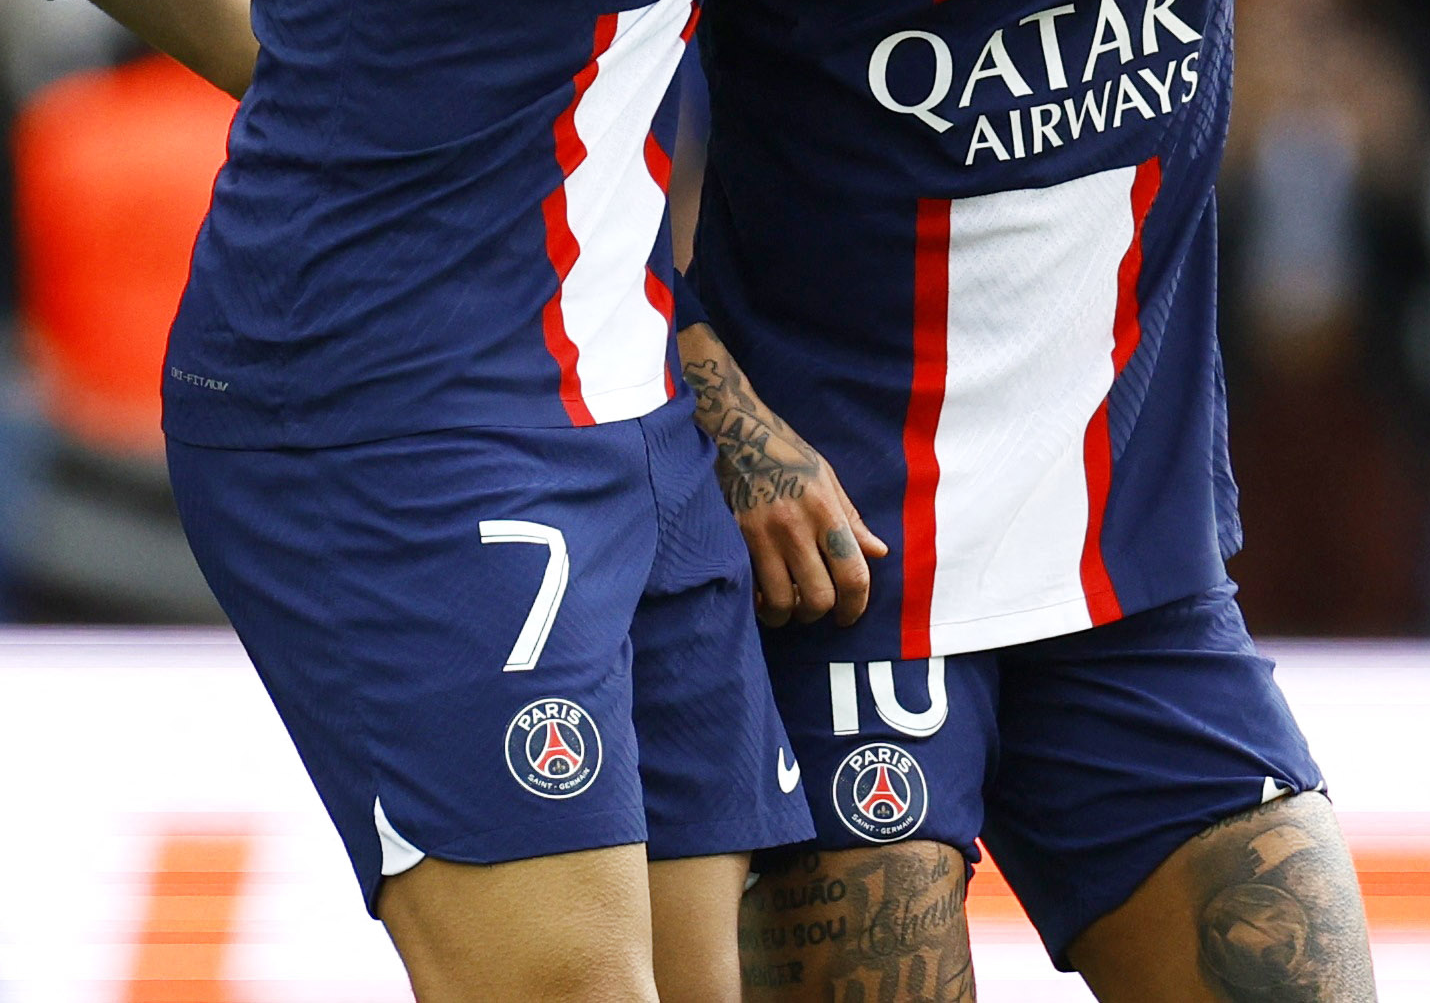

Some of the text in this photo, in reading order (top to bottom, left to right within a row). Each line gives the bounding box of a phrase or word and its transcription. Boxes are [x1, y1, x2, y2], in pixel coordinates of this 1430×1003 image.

[965, 51, 1199, 166] AIRWAYS
[478, 519, 570, 672] 7
[517, 703, 582, 731] PARIS
[849, 747, 912, 774] PARIS
[527, 773, 553, 790] SAINT
[851, 813, 876, 833] SAINT
[880, 815, 914, 835] GERMAIN
